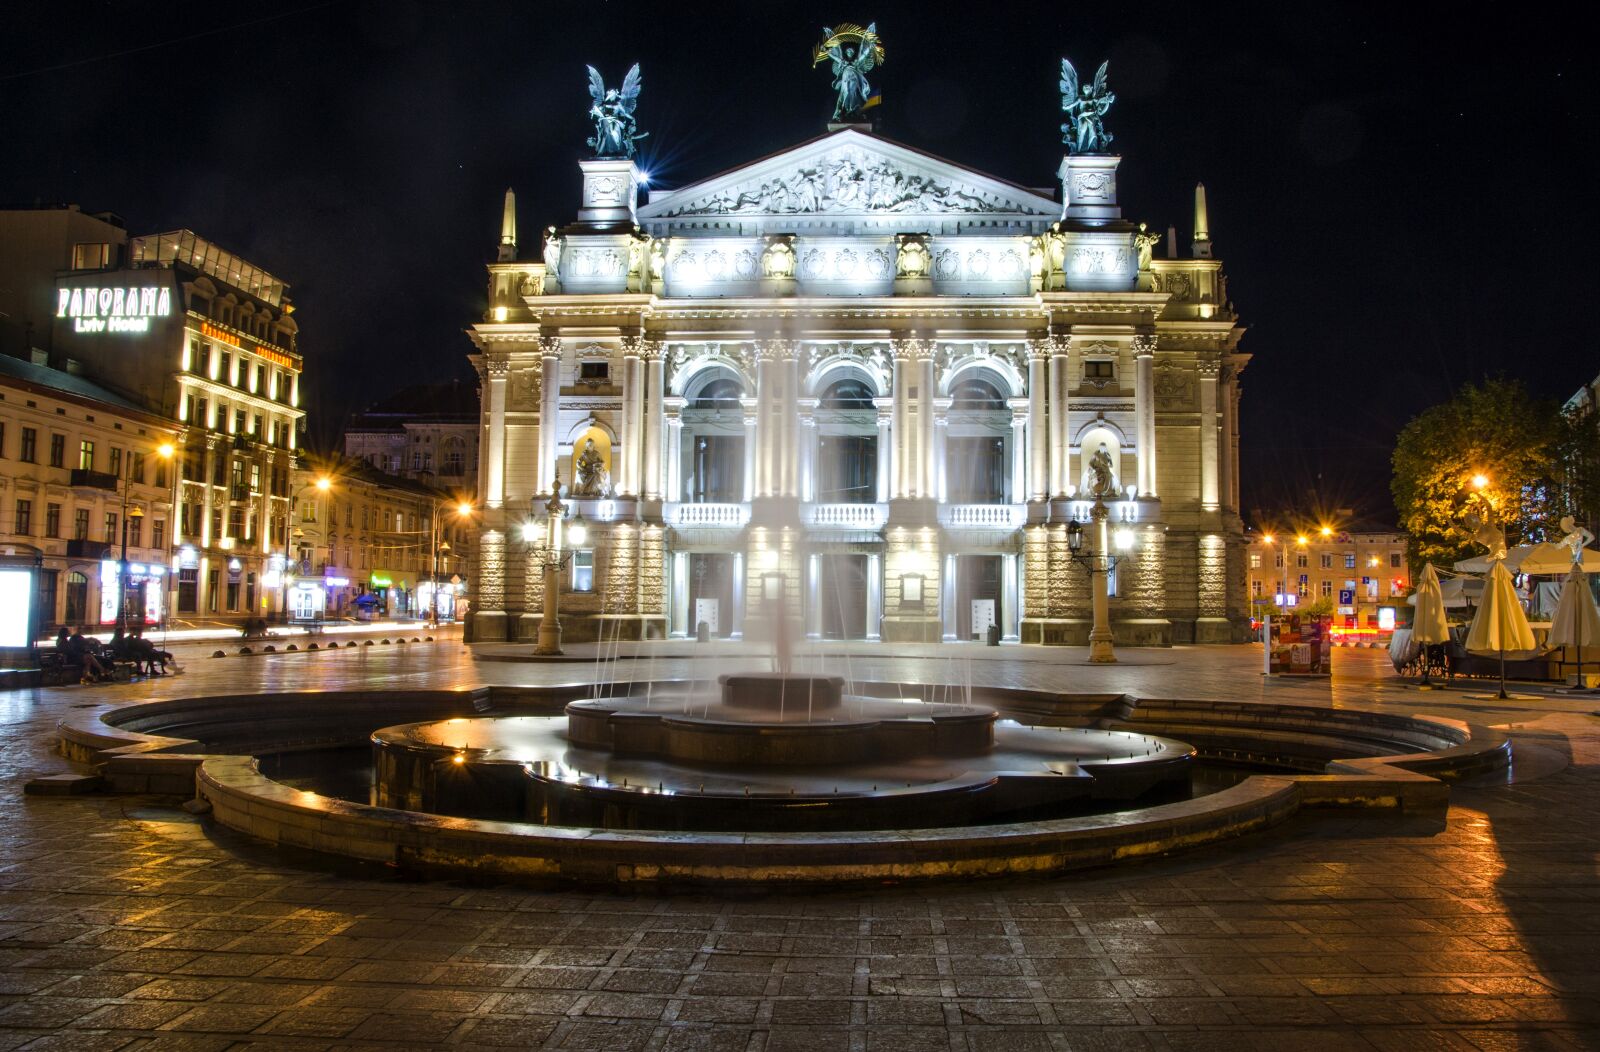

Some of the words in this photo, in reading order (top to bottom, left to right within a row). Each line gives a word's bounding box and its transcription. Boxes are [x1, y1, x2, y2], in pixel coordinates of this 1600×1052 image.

[57, 287, 170, 317] PANORAMA
[75, 317, 105, 332] Lviv
[108, 316, 149, 332] Hotel
